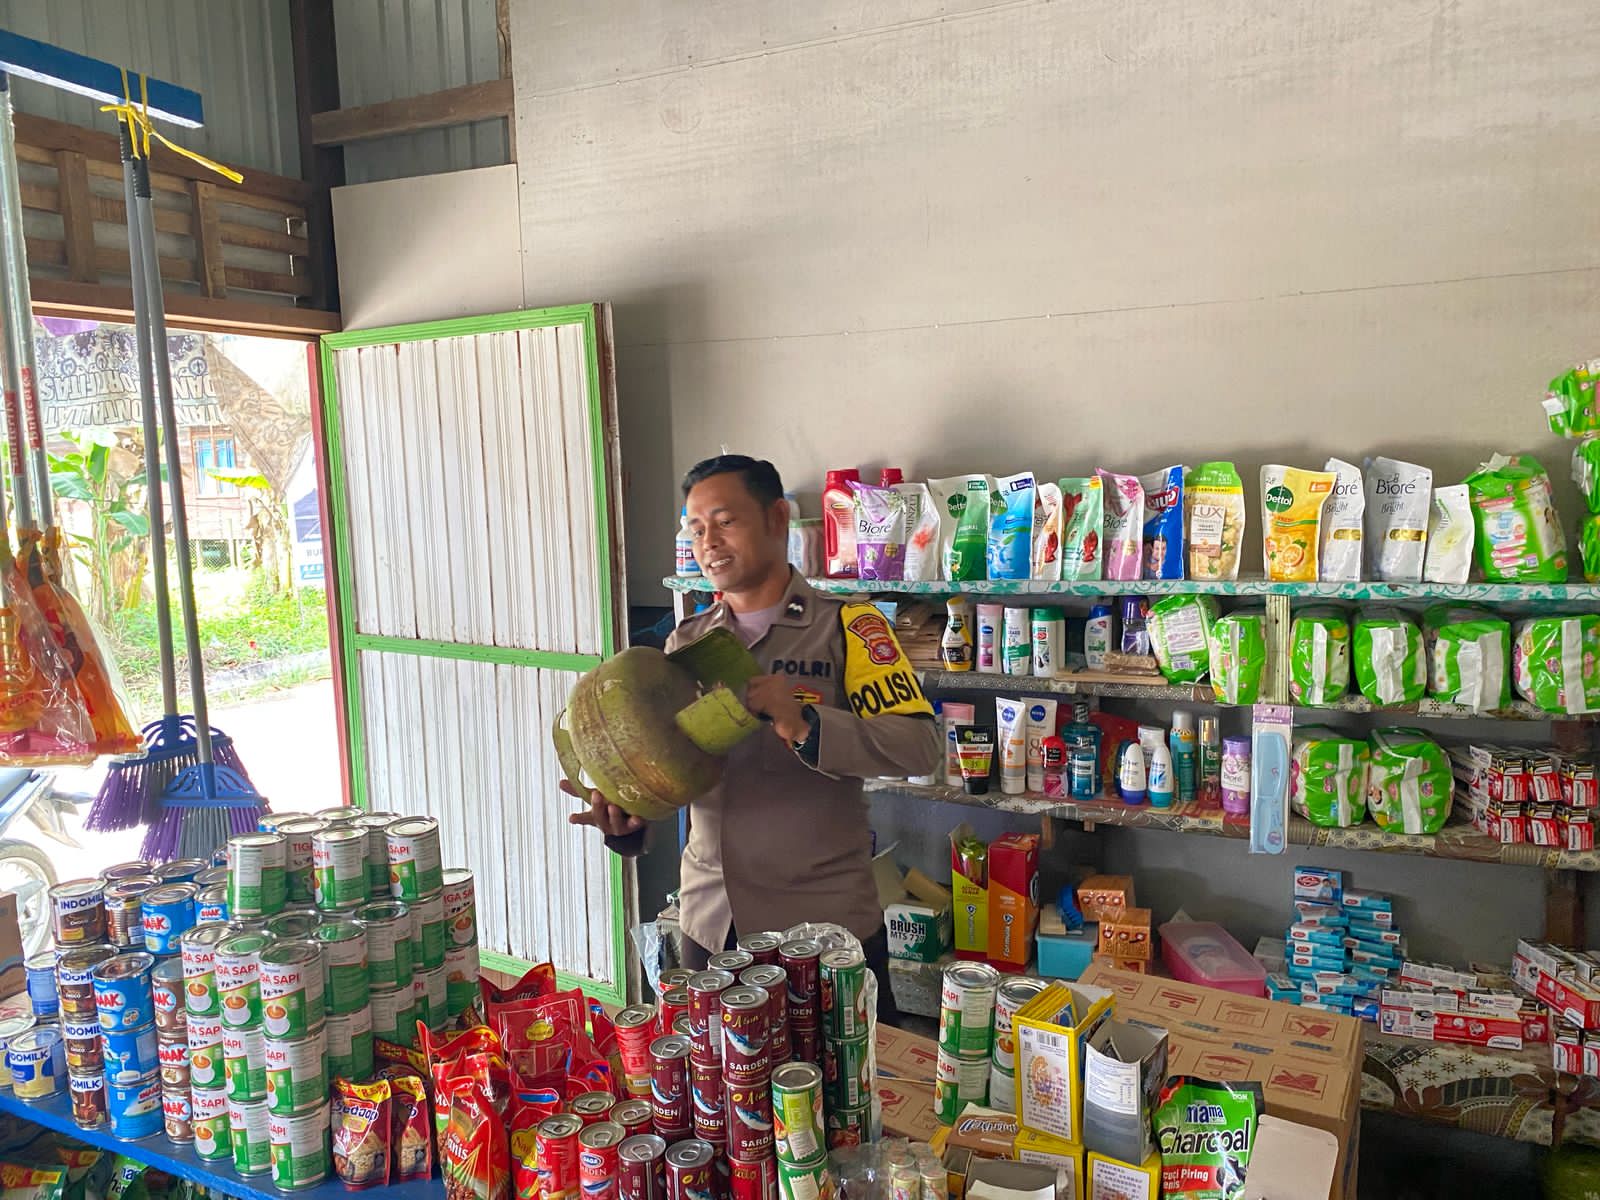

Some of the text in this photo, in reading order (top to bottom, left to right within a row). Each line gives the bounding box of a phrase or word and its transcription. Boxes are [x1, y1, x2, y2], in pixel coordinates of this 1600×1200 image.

[1376, 478, 1416, 495] Bioré
[1266, 494, 1292, 506] Dettol
[1193, 505, 1223, 518] LUX
[771, 659, 831, 677] POLRI
[852, 671, 916, 719] POLISI
[890, 919, 926, 935] BRUSH
[890, 931, 907, 941] MTS
[232, 963, 259, 976] SAPI
[273, 973, 300, 985] SAPI
[730, 1058, 768, 1070] SARDEN
[202, 1097, 225, 1107] SAPI
[1185, 1104, 1224, 1123] mama
[1159, 1118, 1250, 1154] Charcoal
[1181, 1168, 1209, 1182] Piring
